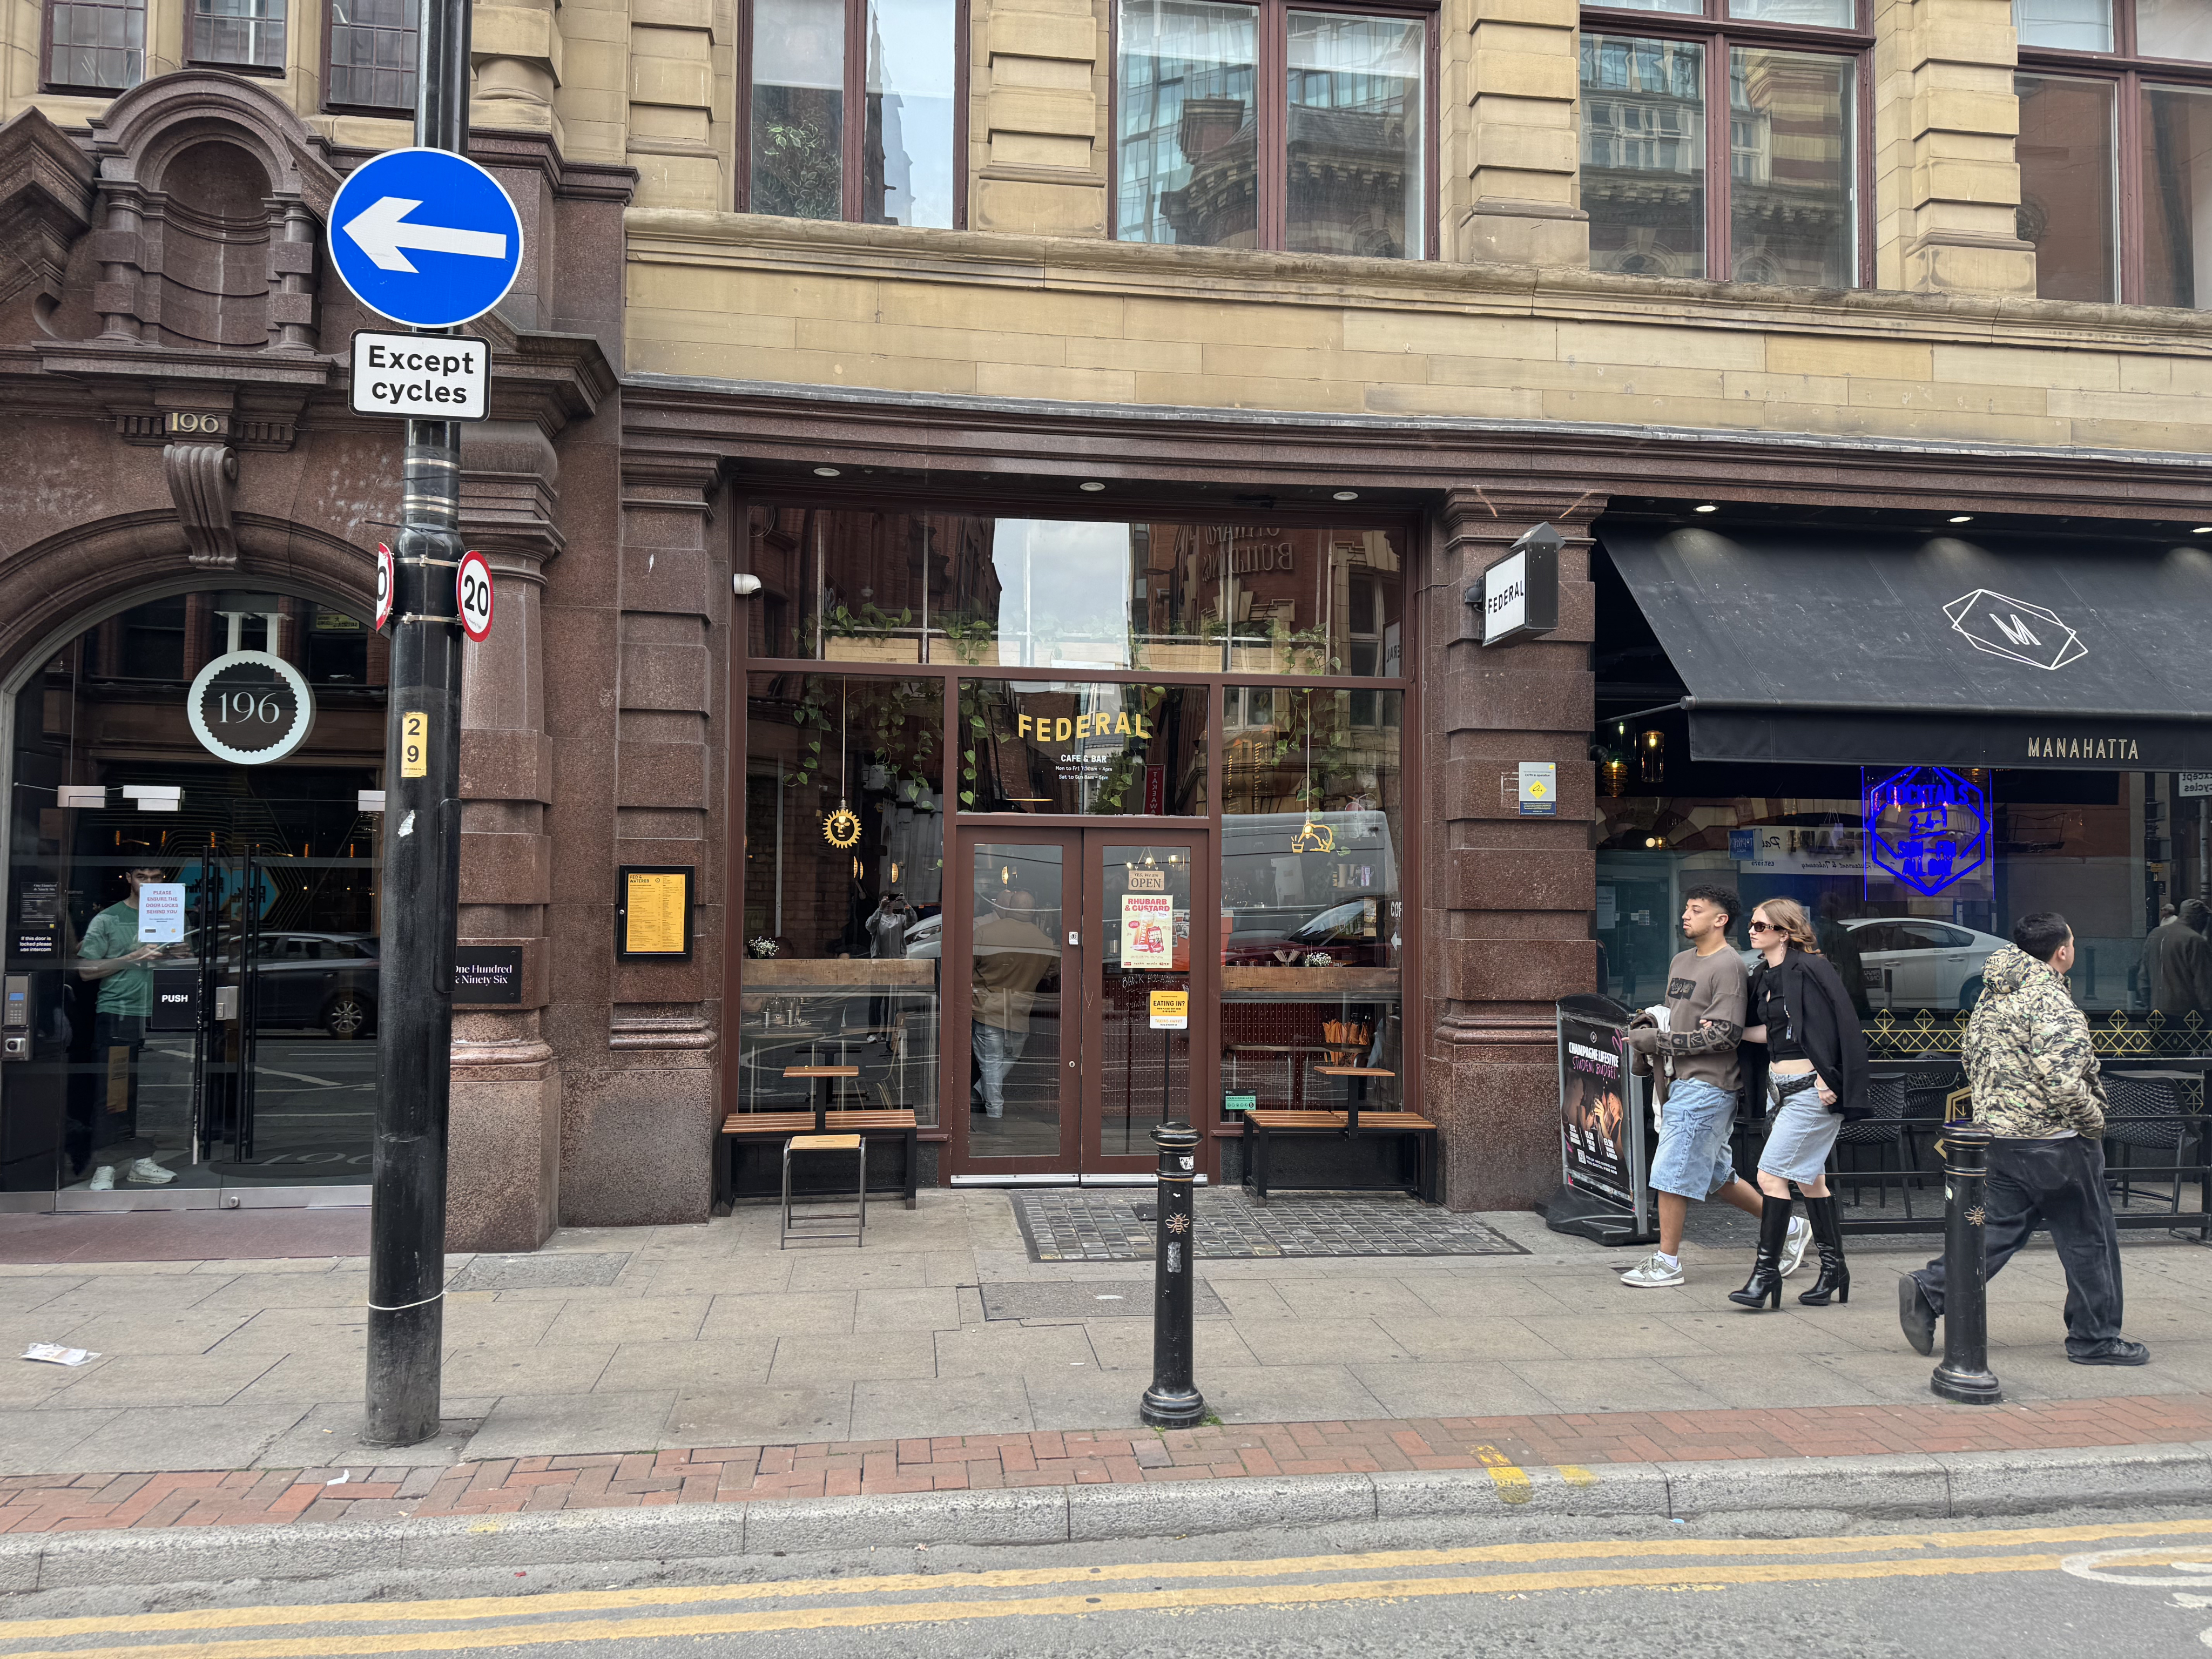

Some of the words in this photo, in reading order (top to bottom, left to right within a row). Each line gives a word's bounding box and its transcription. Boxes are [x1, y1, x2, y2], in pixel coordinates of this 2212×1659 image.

[369, 345, 474, 376] Except
[372, 380, 467, 404] cycles
[172, 412, 219, 433] 196
[464, 575, 488, 616] 20
[1488, 580, 1523, 614] FEDERAL
[1988, 613, 2041, 645] M
[218, 691, 280, 725] 196
[1019, 712, 1150, 742] FEDERAL
[1061, 754, 1081, 762] CAFE
[1083, 754, 1089, 763] &
[2028, 737, 2139, 759] MANAHATTA
[1886, 784, 1969, 805] COCKTAILS
[1902, 858, 1927, 876] ALL
[1131, 878, 1161, 888] OPEN
[472, 965, 512, 973] Hundred
[462, 975, 492, 986] Ninety
[493, 975, 508, 983] Six
[1122, 974, 1144, 988] BANK
[161, 994, 188, 1003] PUSH
[1569, 1042, 1598, 1061] CHAMPAGNE
[1598, 1050, 1619, 1068] LIFESTYLE
[1573, 1056, 1595, 1074] STUDENT
[1596, 1063, 1617, 1079] BUDGET
